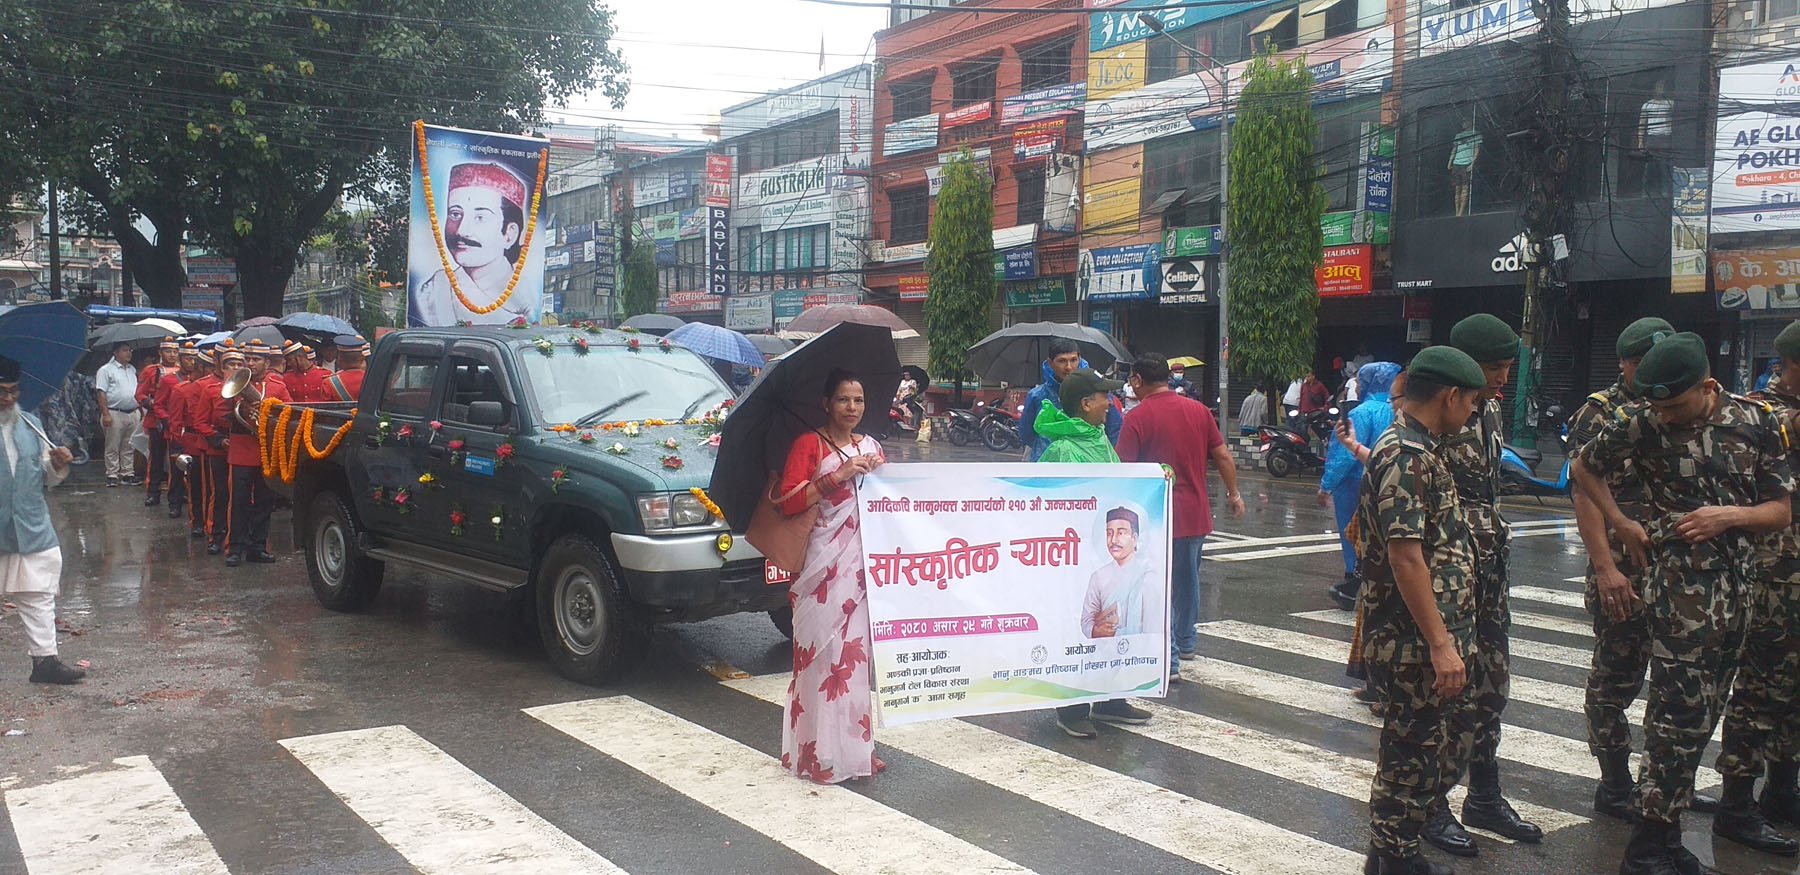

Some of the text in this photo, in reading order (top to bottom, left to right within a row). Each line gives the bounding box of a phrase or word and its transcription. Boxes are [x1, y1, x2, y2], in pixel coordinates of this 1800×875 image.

[1116, 18, 1186, 42] EDUCAION
[1733, 128, 1760, 148] AE
[761, 165, 825, 199] AUSTRALIA
[713, 209, 726, 293] BABYLAND
[1165, 268, 1200, 284] Caliber
[1397, 279, 1433, 289] TRUST MART
[1160, 295, 1178, 304] MADE
[1186, 294, 1207, 303] NEPAL
[867, 496, 910, 513] आदिकवि
[913, 498, 957, 516] भानुभक्त
[961, 496, 1005, 512] आचार्यको
[1045, 495, 1098, 511] जन्मजयन्ती
[868, 537, 1001, 590] सांस्कृतिक
[933, 620, 959, 635] असार
[981, 616, 994, 631] गते
[997, 615, 1030, 633] शुक्रवार
[1064, 642, 1097, 657] आयोजक
[923, 677, 948, 690] विकास
